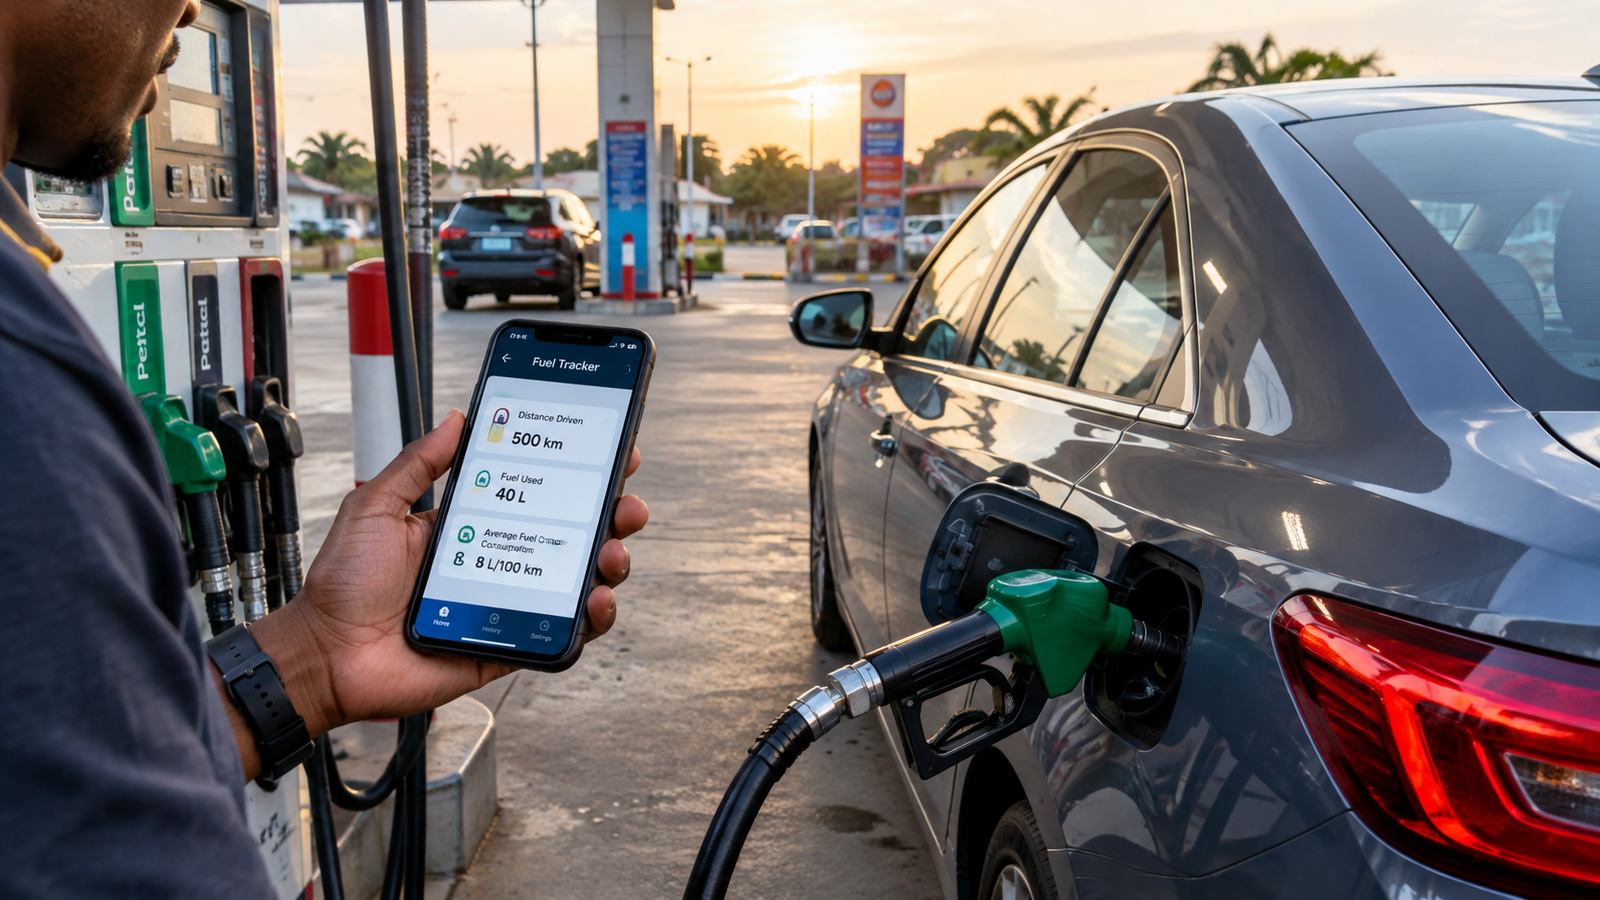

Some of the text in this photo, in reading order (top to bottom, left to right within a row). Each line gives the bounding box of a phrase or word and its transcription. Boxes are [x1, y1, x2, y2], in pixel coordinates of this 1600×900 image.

[532, 357, 600, 372] Fuel Tracker
[518, 411, 583, 425] Distance Driven
[512, 431, 563, 450] 500 km
[500, 472, 543, 485] Fuel Used
[495, 487, 526, 503] 40 L
[483, 528, 518, 541] Average
[519, 532, 537, 543] Fuel
[475, 556, 543, 577] 8 L/100 km
